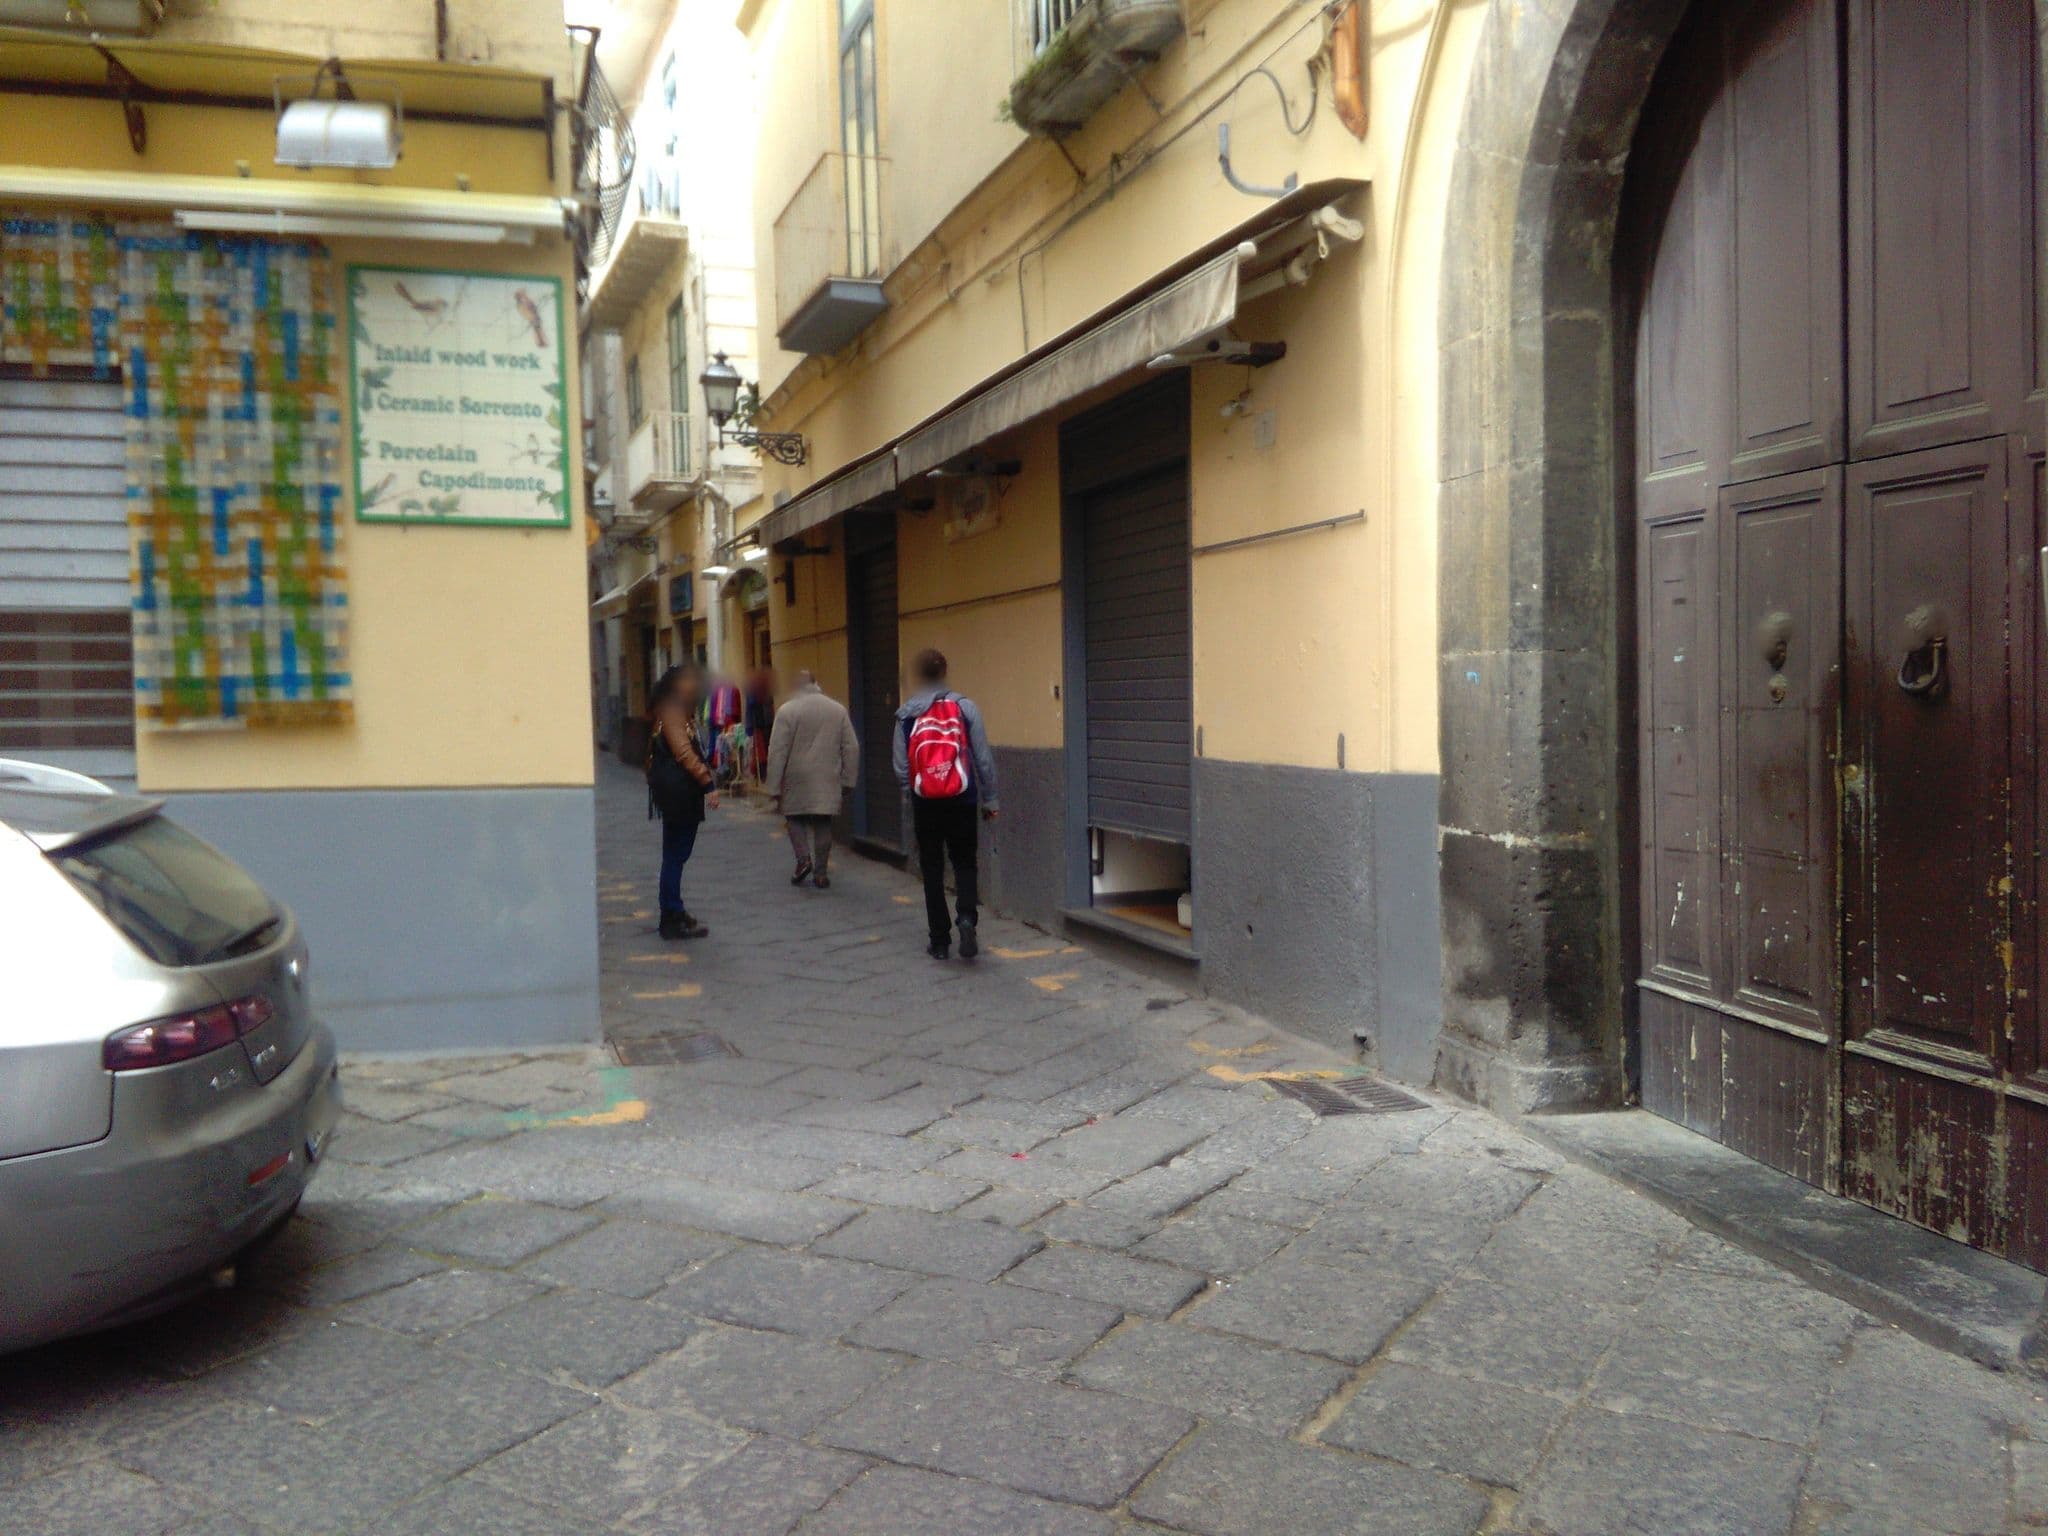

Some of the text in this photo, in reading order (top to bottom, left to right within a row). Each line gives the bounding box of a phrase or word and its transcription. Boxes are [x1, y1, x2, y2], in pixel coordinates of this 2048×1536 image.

[376, 343, 541, 370] Inlaid wood work
[377, 393, 543, 418] Ceramic Sorrento
[379, 441, 478, 463] Porcelain
[418, 470, 546, 492] Capodimonte
